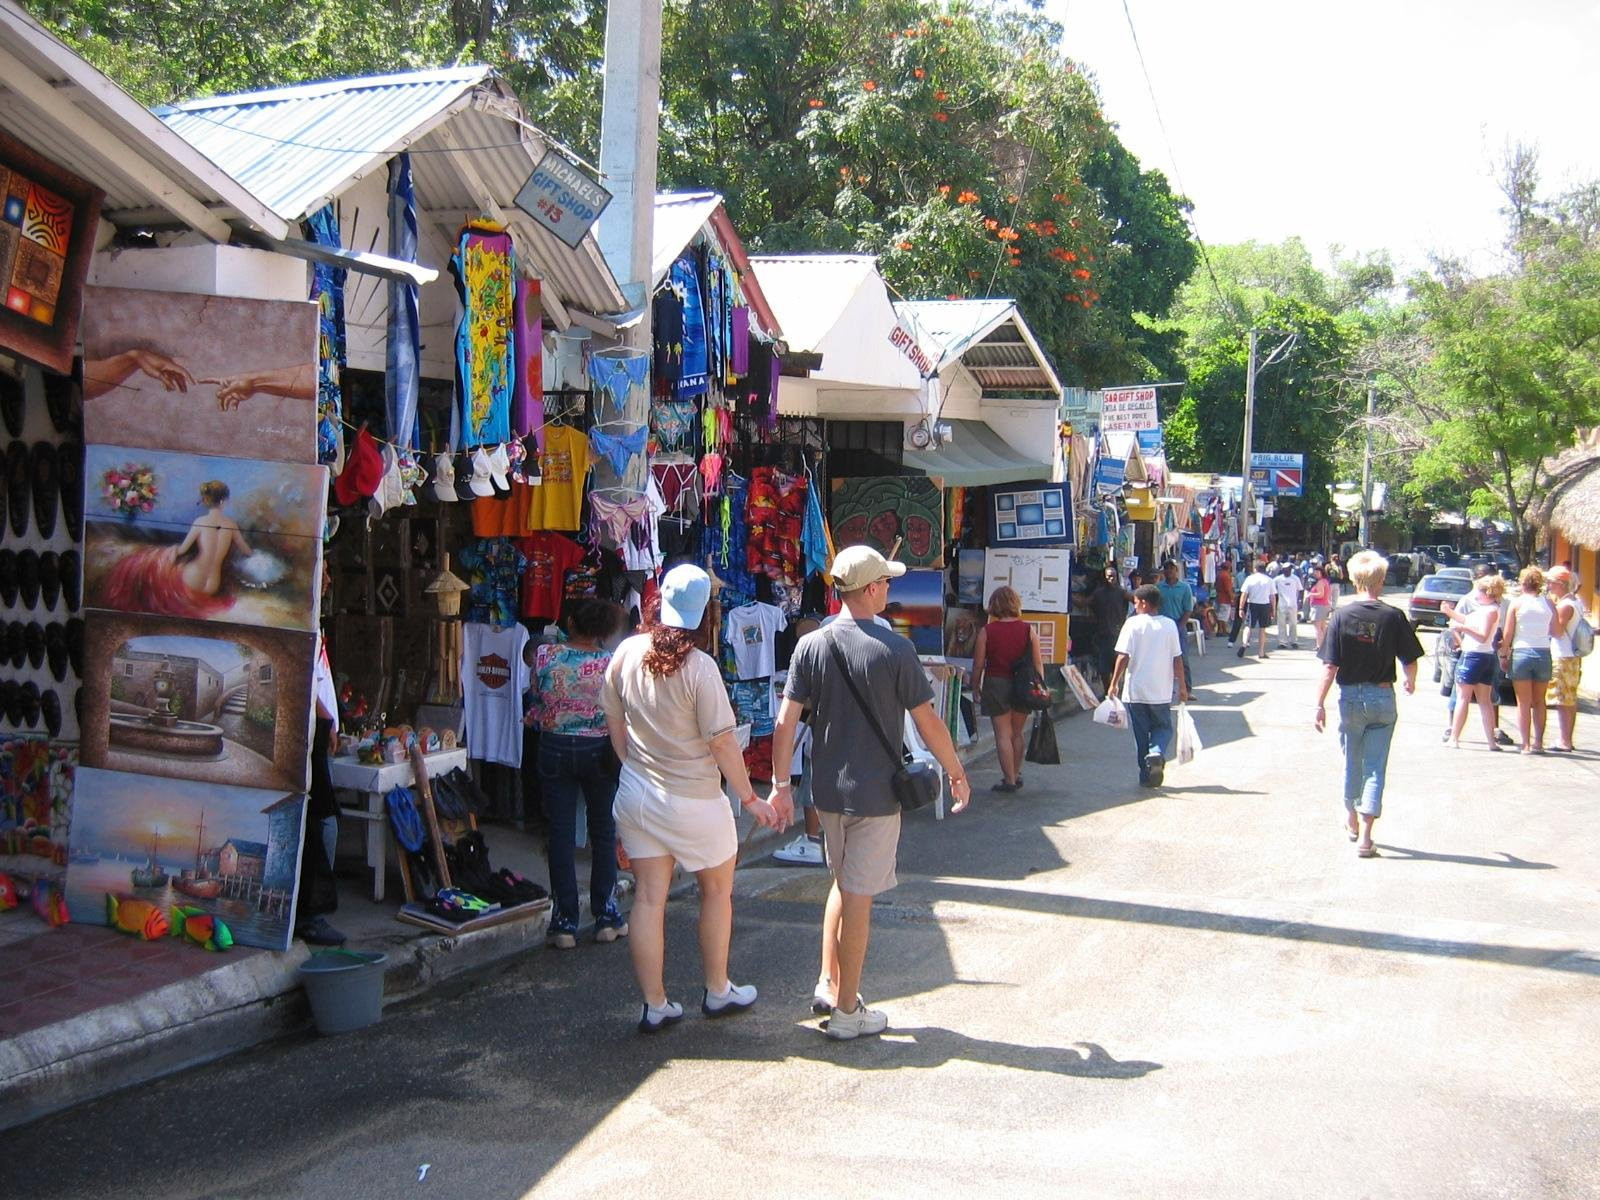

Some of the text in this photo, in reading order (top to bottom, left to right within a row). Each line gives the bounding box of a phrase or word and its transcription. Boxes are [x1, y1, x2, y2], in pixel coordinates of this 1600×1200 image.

[541, 157, 604, 206] MICHAEL'S
[532, 172, 594, 221] GIFT SHOP
[537, 199, 563, 224] #13
[891, 326, 933, 374] GIFT SHOP
[1118, 391, 1134, 402] GIFT
[1136, 390, 1154, 401] SHOP
[1116, 413, 1130, 421] BEST
[1273, 454, 1295, 462] BLUE
[799, 846, 805, 855] 3
